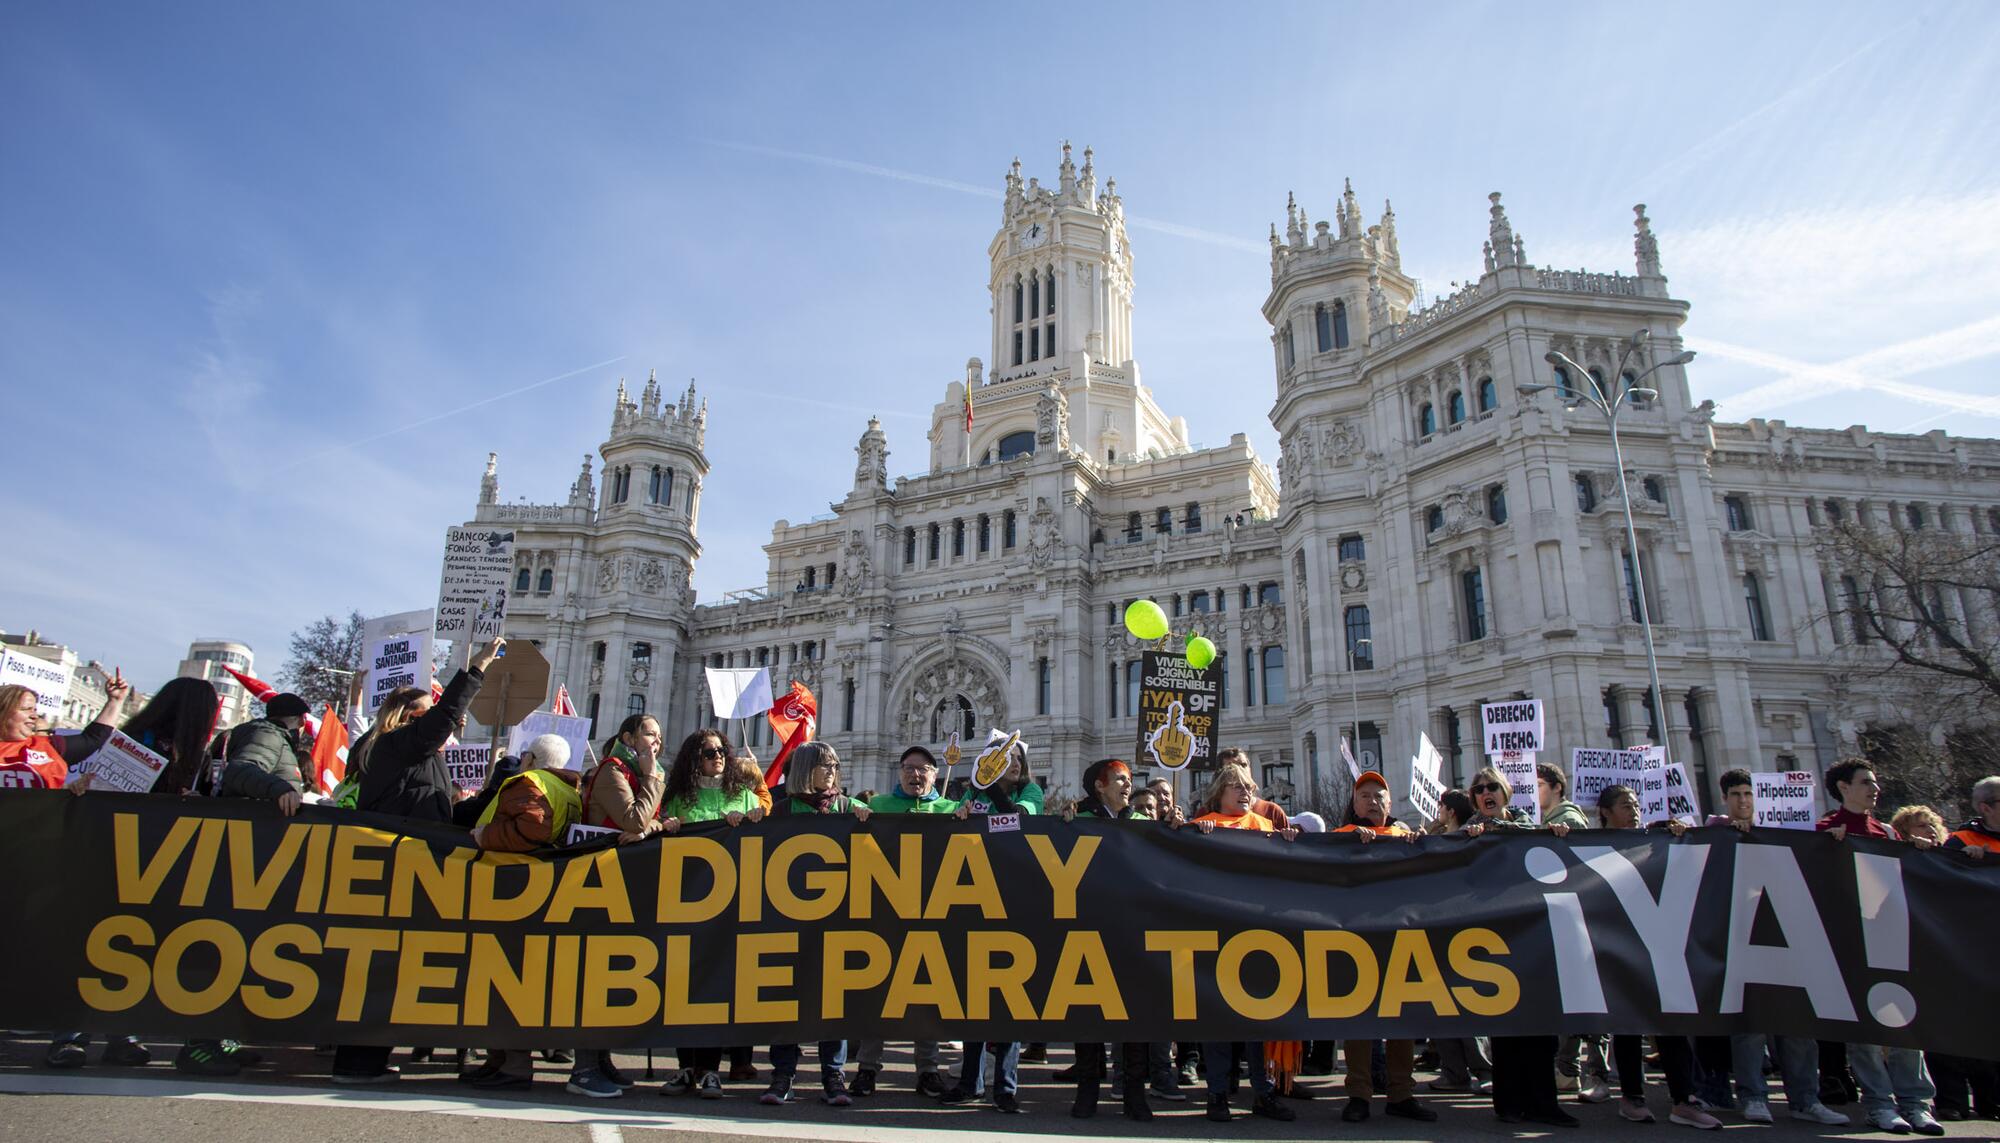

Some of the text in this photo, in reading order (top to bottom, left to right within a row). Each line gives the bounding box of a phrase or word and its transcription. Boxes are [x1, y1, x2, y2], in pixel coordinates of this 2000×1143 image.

[452, 531, 489, 542] BANCOS
[447, 544, 481, 553] FONDOS
[441, 607, 466, 615] CASAS
[436, 619, 465, 631] BASTA
[384, 640, 409, 656] BANCO
[375, 651, 417, 670] SANTANDER
[1155, 656, 1209, 670] VIVIEN
[36, 667, 65, 685] prisiones
[1157, 667, 1205, 680] DIGNA Y
[377, 673, 414, 692] CERBERUS
[1145, 676, 1217, 691] SOSTENIBLE
[1189, 693, 1217, 712] 9F
[1487, 704, 1535, 724] DERECHO
[1491, 731, 1538, 750] A TECHO.
[445, 748, 490, 763] ERECHO
[1612, 754, 1618, 769] A
[1414, 766, 1440, 801] SIN CASA
[1575, 776, 1583, 793] A
[1787, 773, 1812, 781] NO+
[1411, 784, 1416, 799] A
[1415, 789, 1421, 807] LA
[1757, 783, 1808, 800] ¡Hipotecas
[990, 815, 1017, 827] NO+
[1758, 806, 1810, 825] y alquileres
[113, 813, 1103, 924] VIVIENDA DIGNA Y
[1524, 843, 1917, 1027] ¡YA!
[78, 914, 1521, 1027] SOSTENIBLE PARA TODAS
